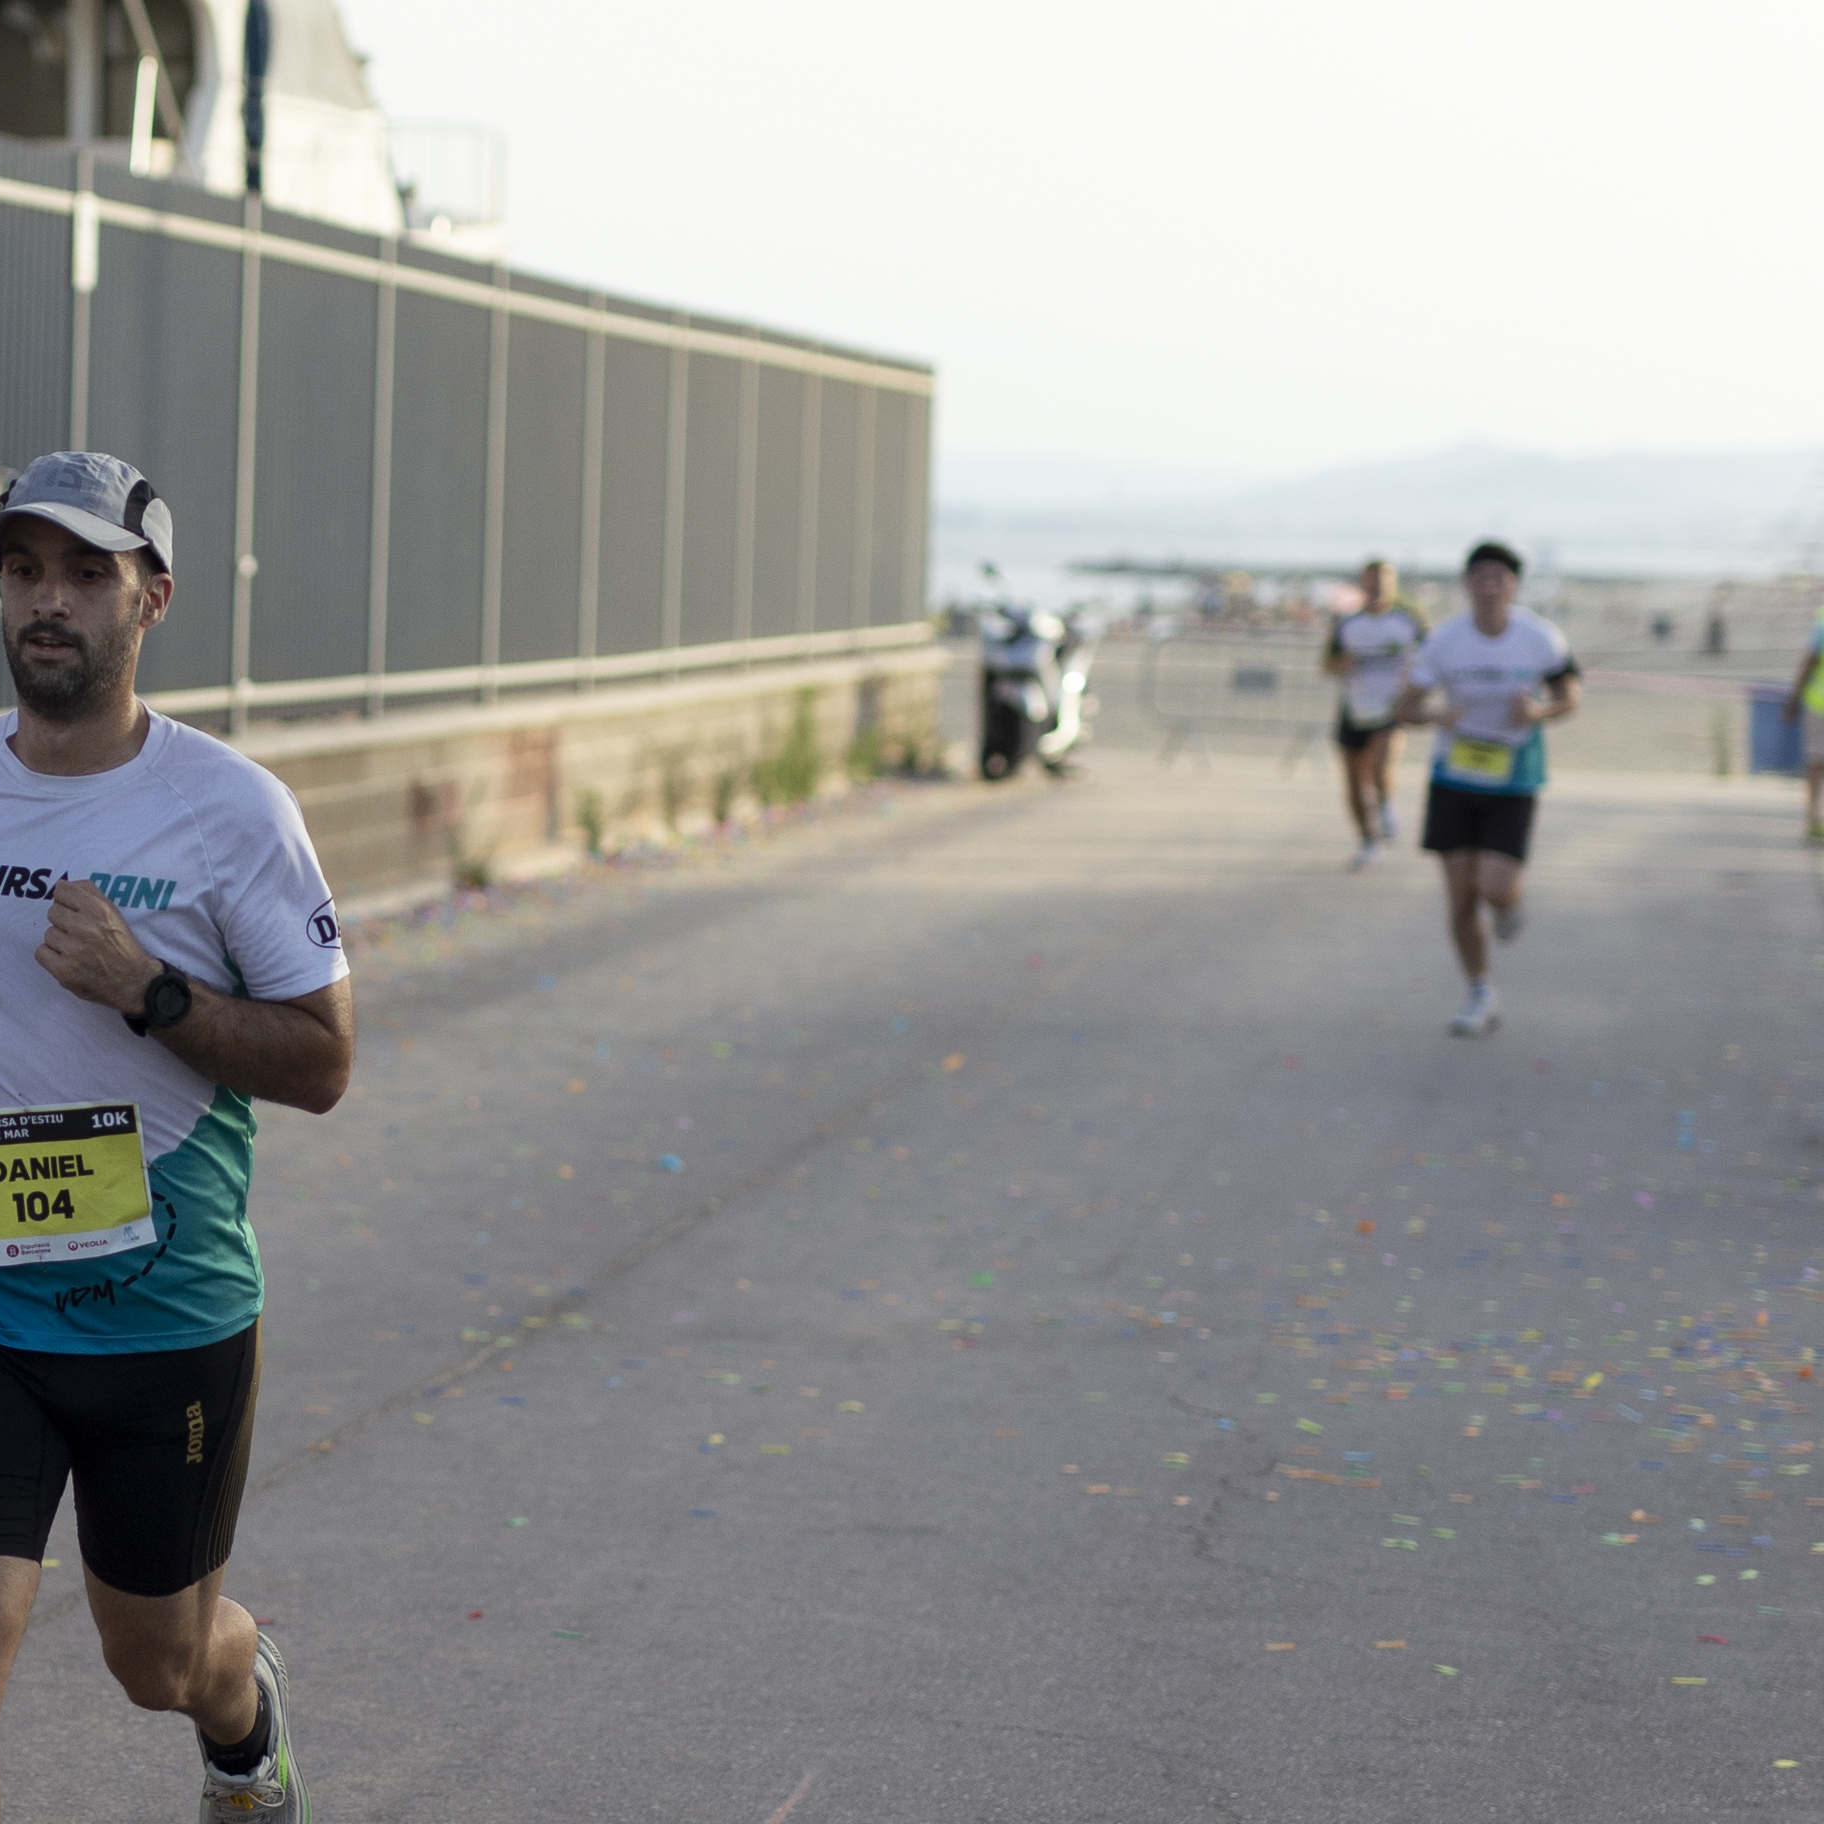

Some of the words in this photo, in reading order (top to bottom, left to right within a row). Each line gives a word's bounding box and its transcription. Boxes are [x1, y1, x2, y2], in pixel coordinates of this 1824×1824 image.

[20, 1114, 64, 1126] D'ESTIU
[91, 1111, 129, 1129] 10K
[4, 1129, 30, 1139] MAR
[12, 1188, 75, 1223] 104
[79, 1238, 109, 1249] VEOLIA
